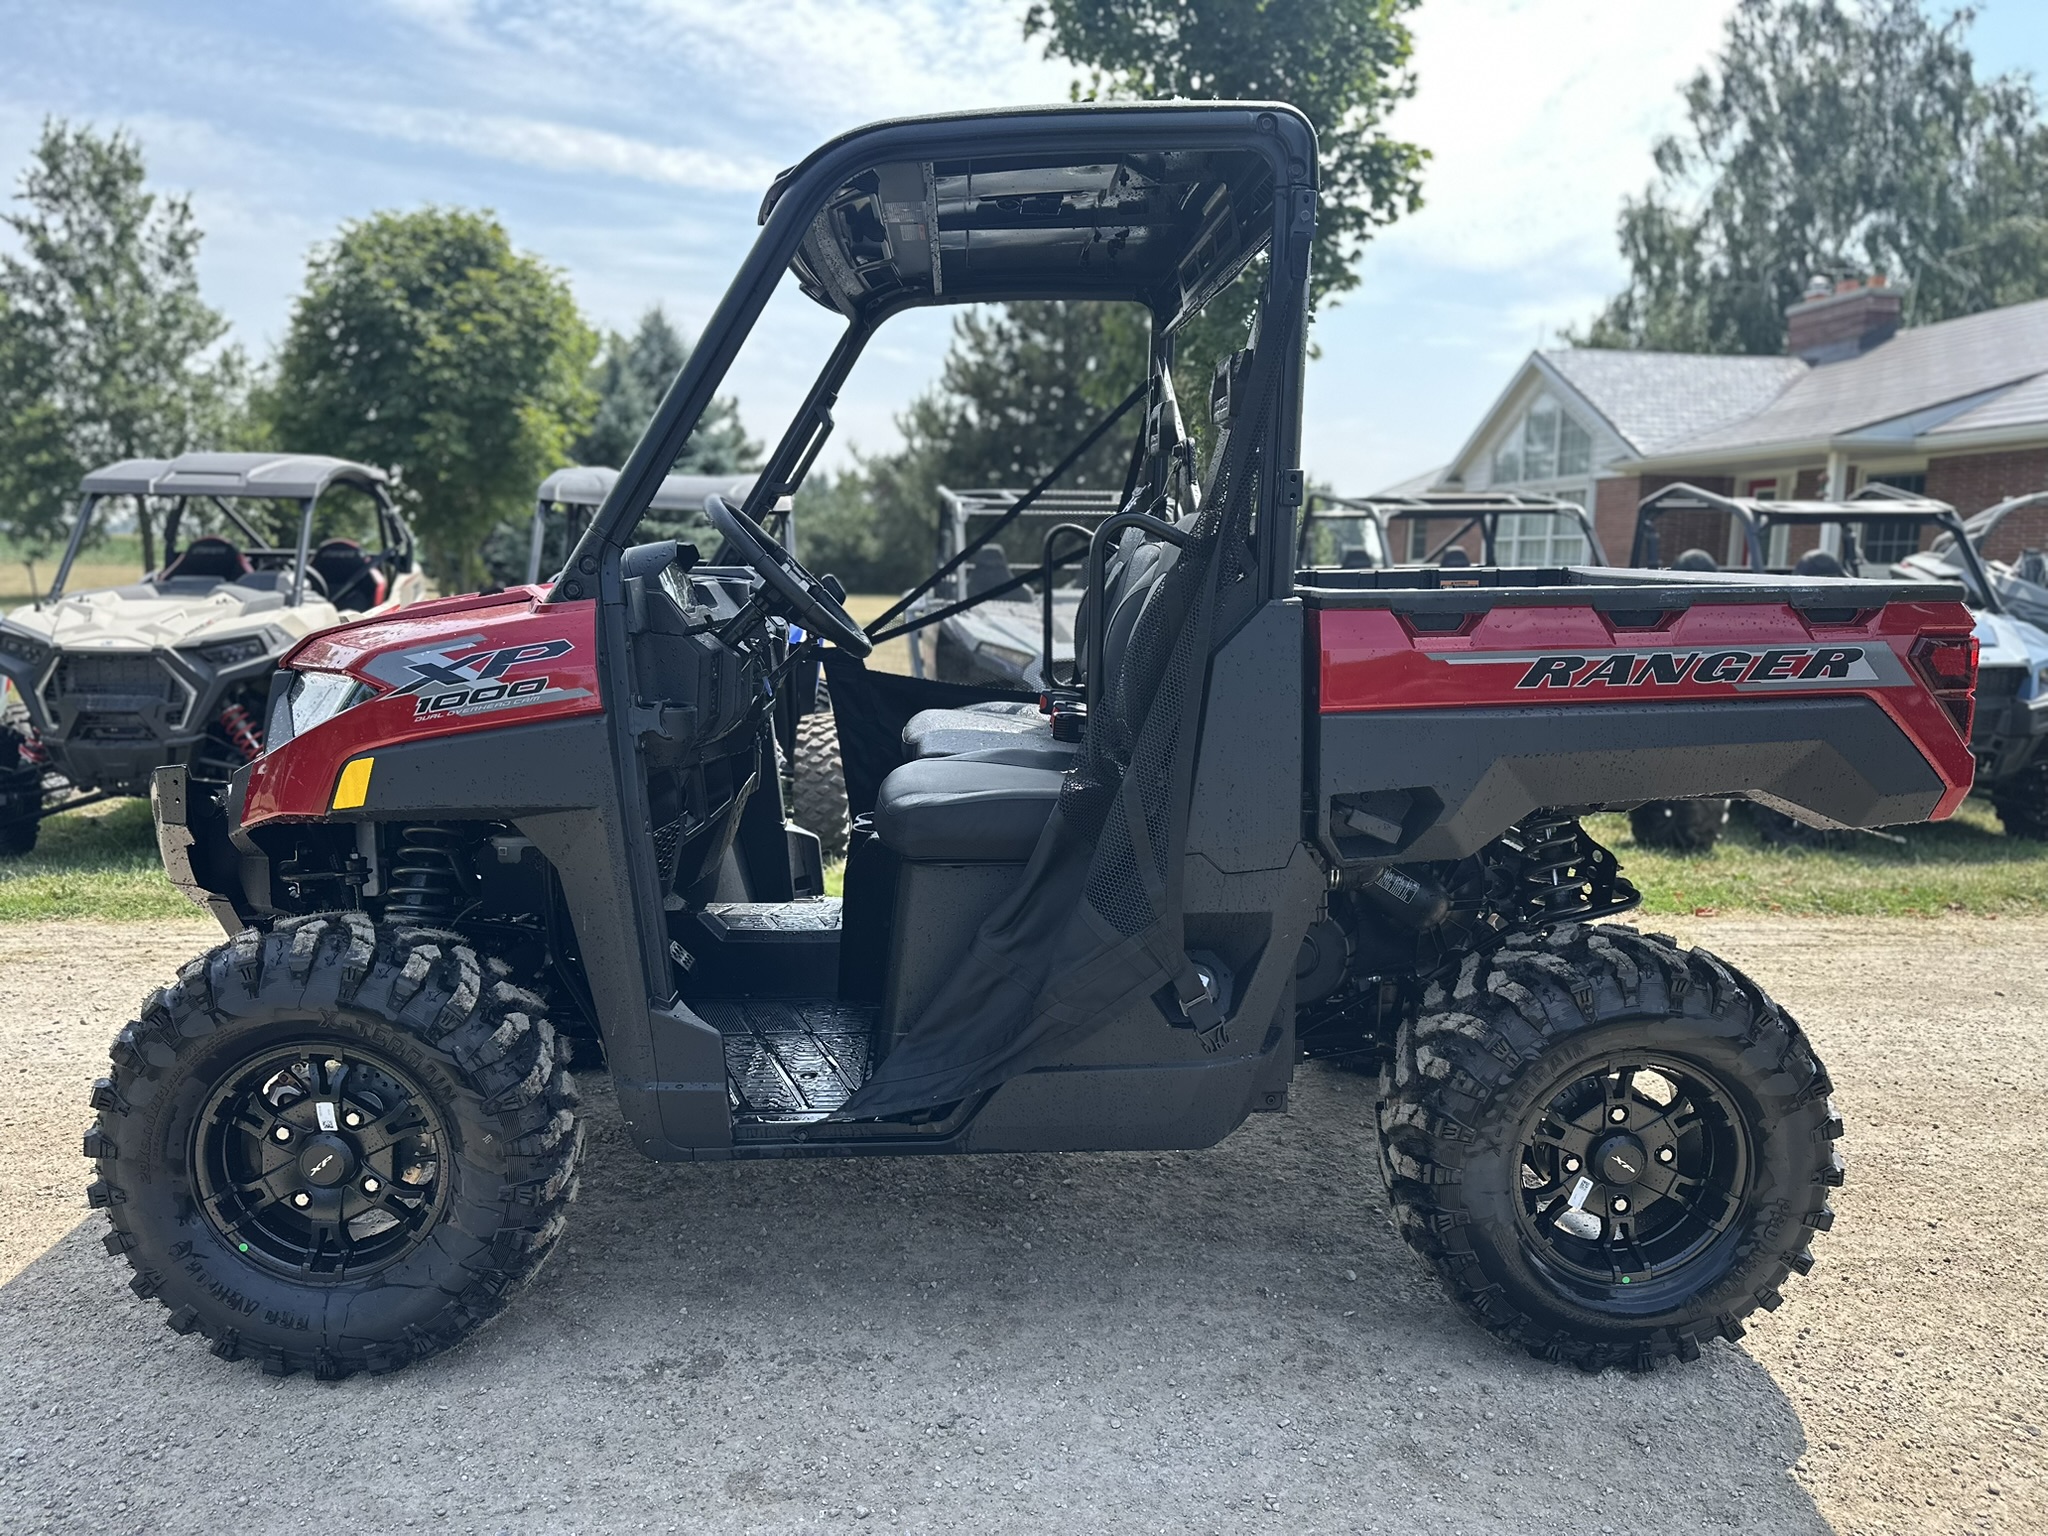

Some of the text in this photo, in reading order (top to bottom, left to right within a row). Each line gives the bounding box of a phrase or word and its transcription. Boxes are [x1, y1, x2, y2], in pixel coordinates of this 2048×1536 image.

[376, 638, 575, 702] XP
[1514, 647, 1865, 689] RANGER
[413, 676, 549, 717] 1000
[414, 695, 541, 723] DUAL OVERHEAD CAM
[319, 1010, 460, 1104] X-TERRAIN
[1486, 1039, 1590, 1158] X-TERRAIN
[310, 1154, 333, 1177] XP
[1610, 1155, 1636, 1174] XP
[1762, 1197, 1792, 1241] PRO
[261, 1309, 311, 1332] PRO
